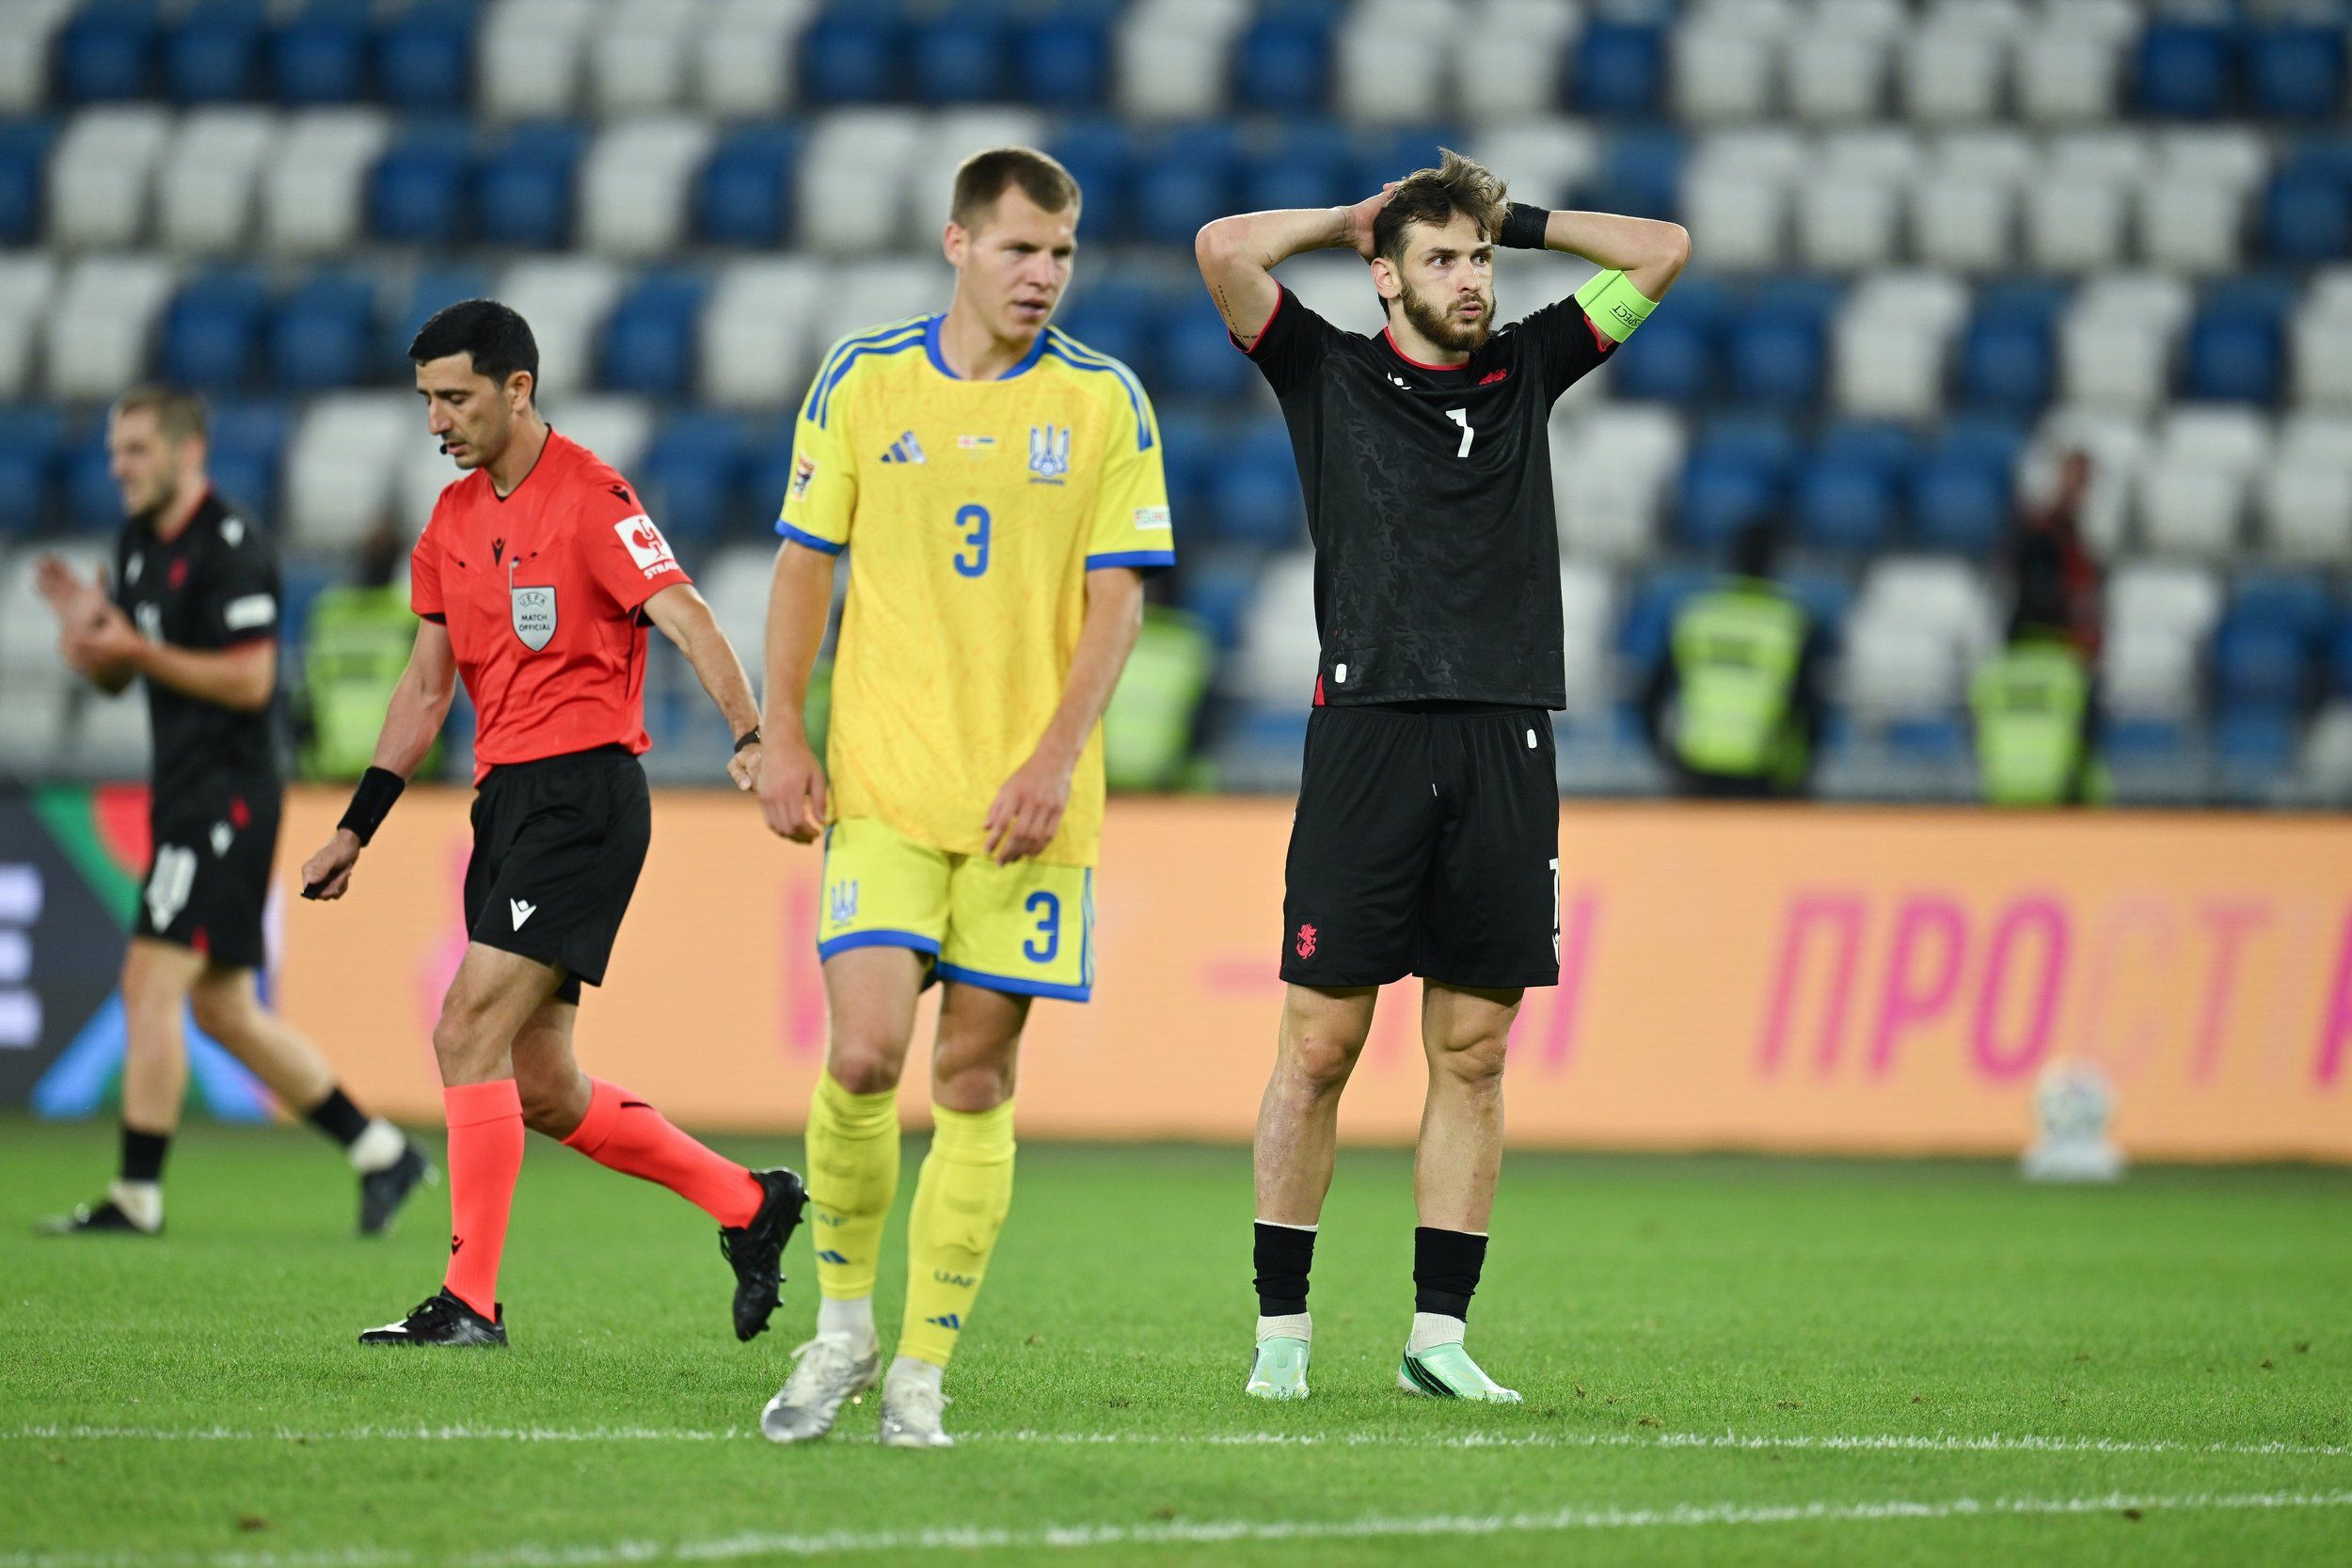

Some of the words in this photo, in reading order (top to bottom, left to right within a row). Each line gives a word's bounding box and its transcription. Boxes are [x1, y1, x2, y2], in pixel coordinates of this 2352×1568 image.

[1445, 406, 1474, 458] 7
[954, 503, 992, 578] 3
[518, 594, 546, 607] UEFA
[518, 624, 551, 632] OFFICIAL
[521, 613, 548, 622] MATCH
[1023, 890, 1061, 964] 3
